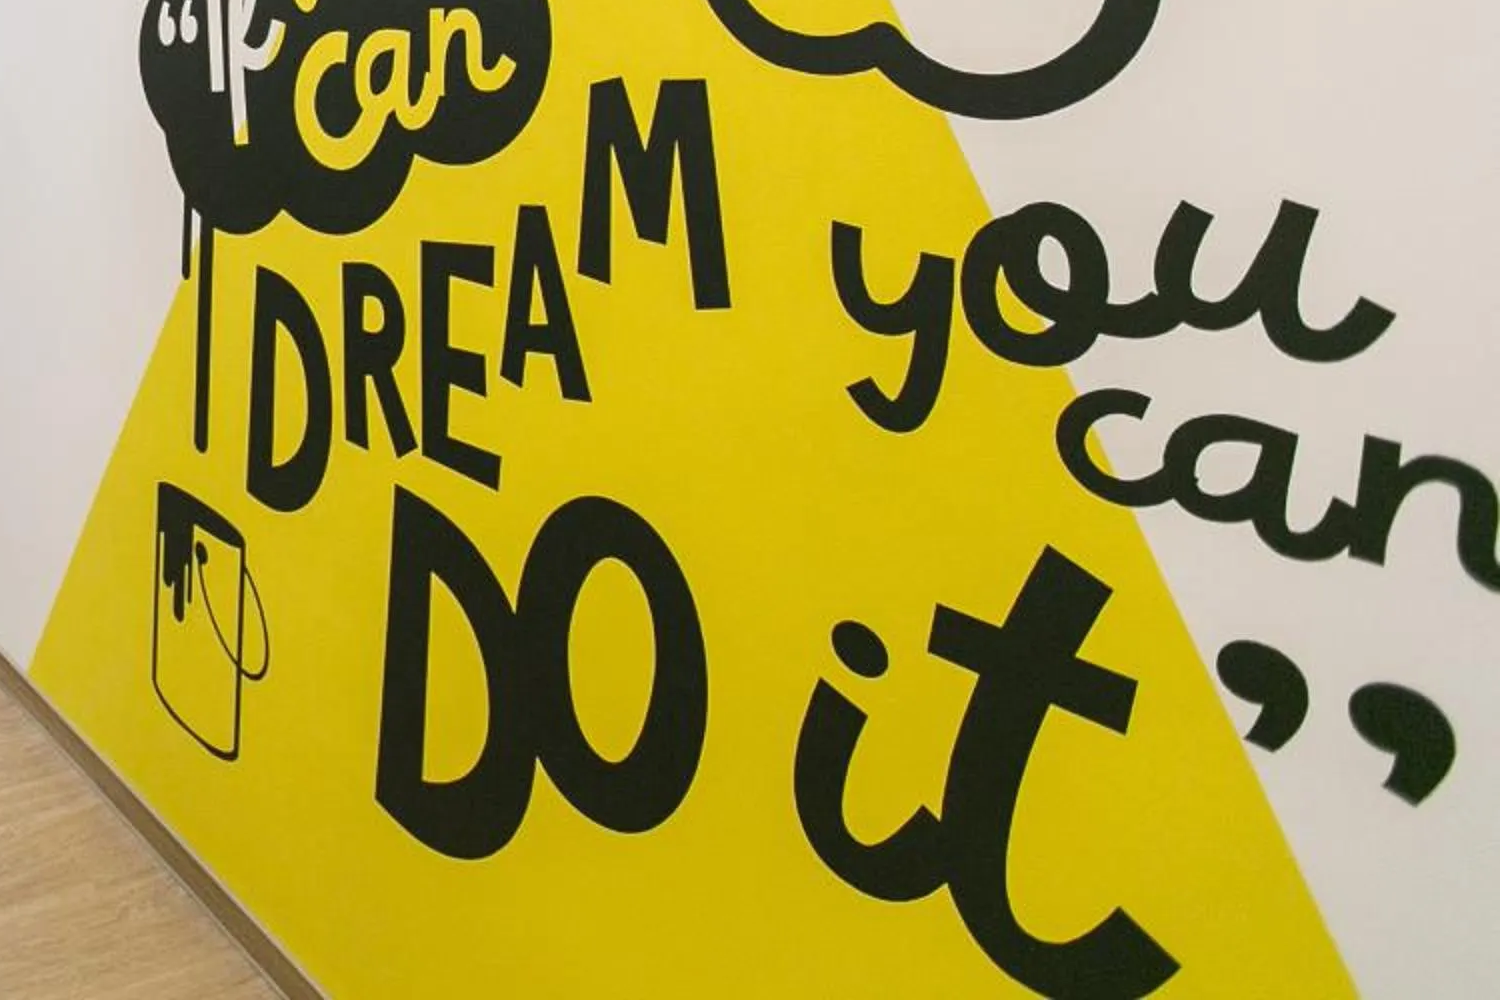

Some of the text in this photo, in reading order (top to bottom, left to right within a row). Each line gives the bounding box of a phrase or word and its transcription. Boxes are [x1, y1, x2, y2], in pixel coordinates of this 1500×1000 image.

[294, 7, 516, 169] can
[246, 76, 732, 513] DREAM
[831, 198, 1397, 433] you
[1055, 387, 1500, 594] can
[375, 483, 709, 861] DO
